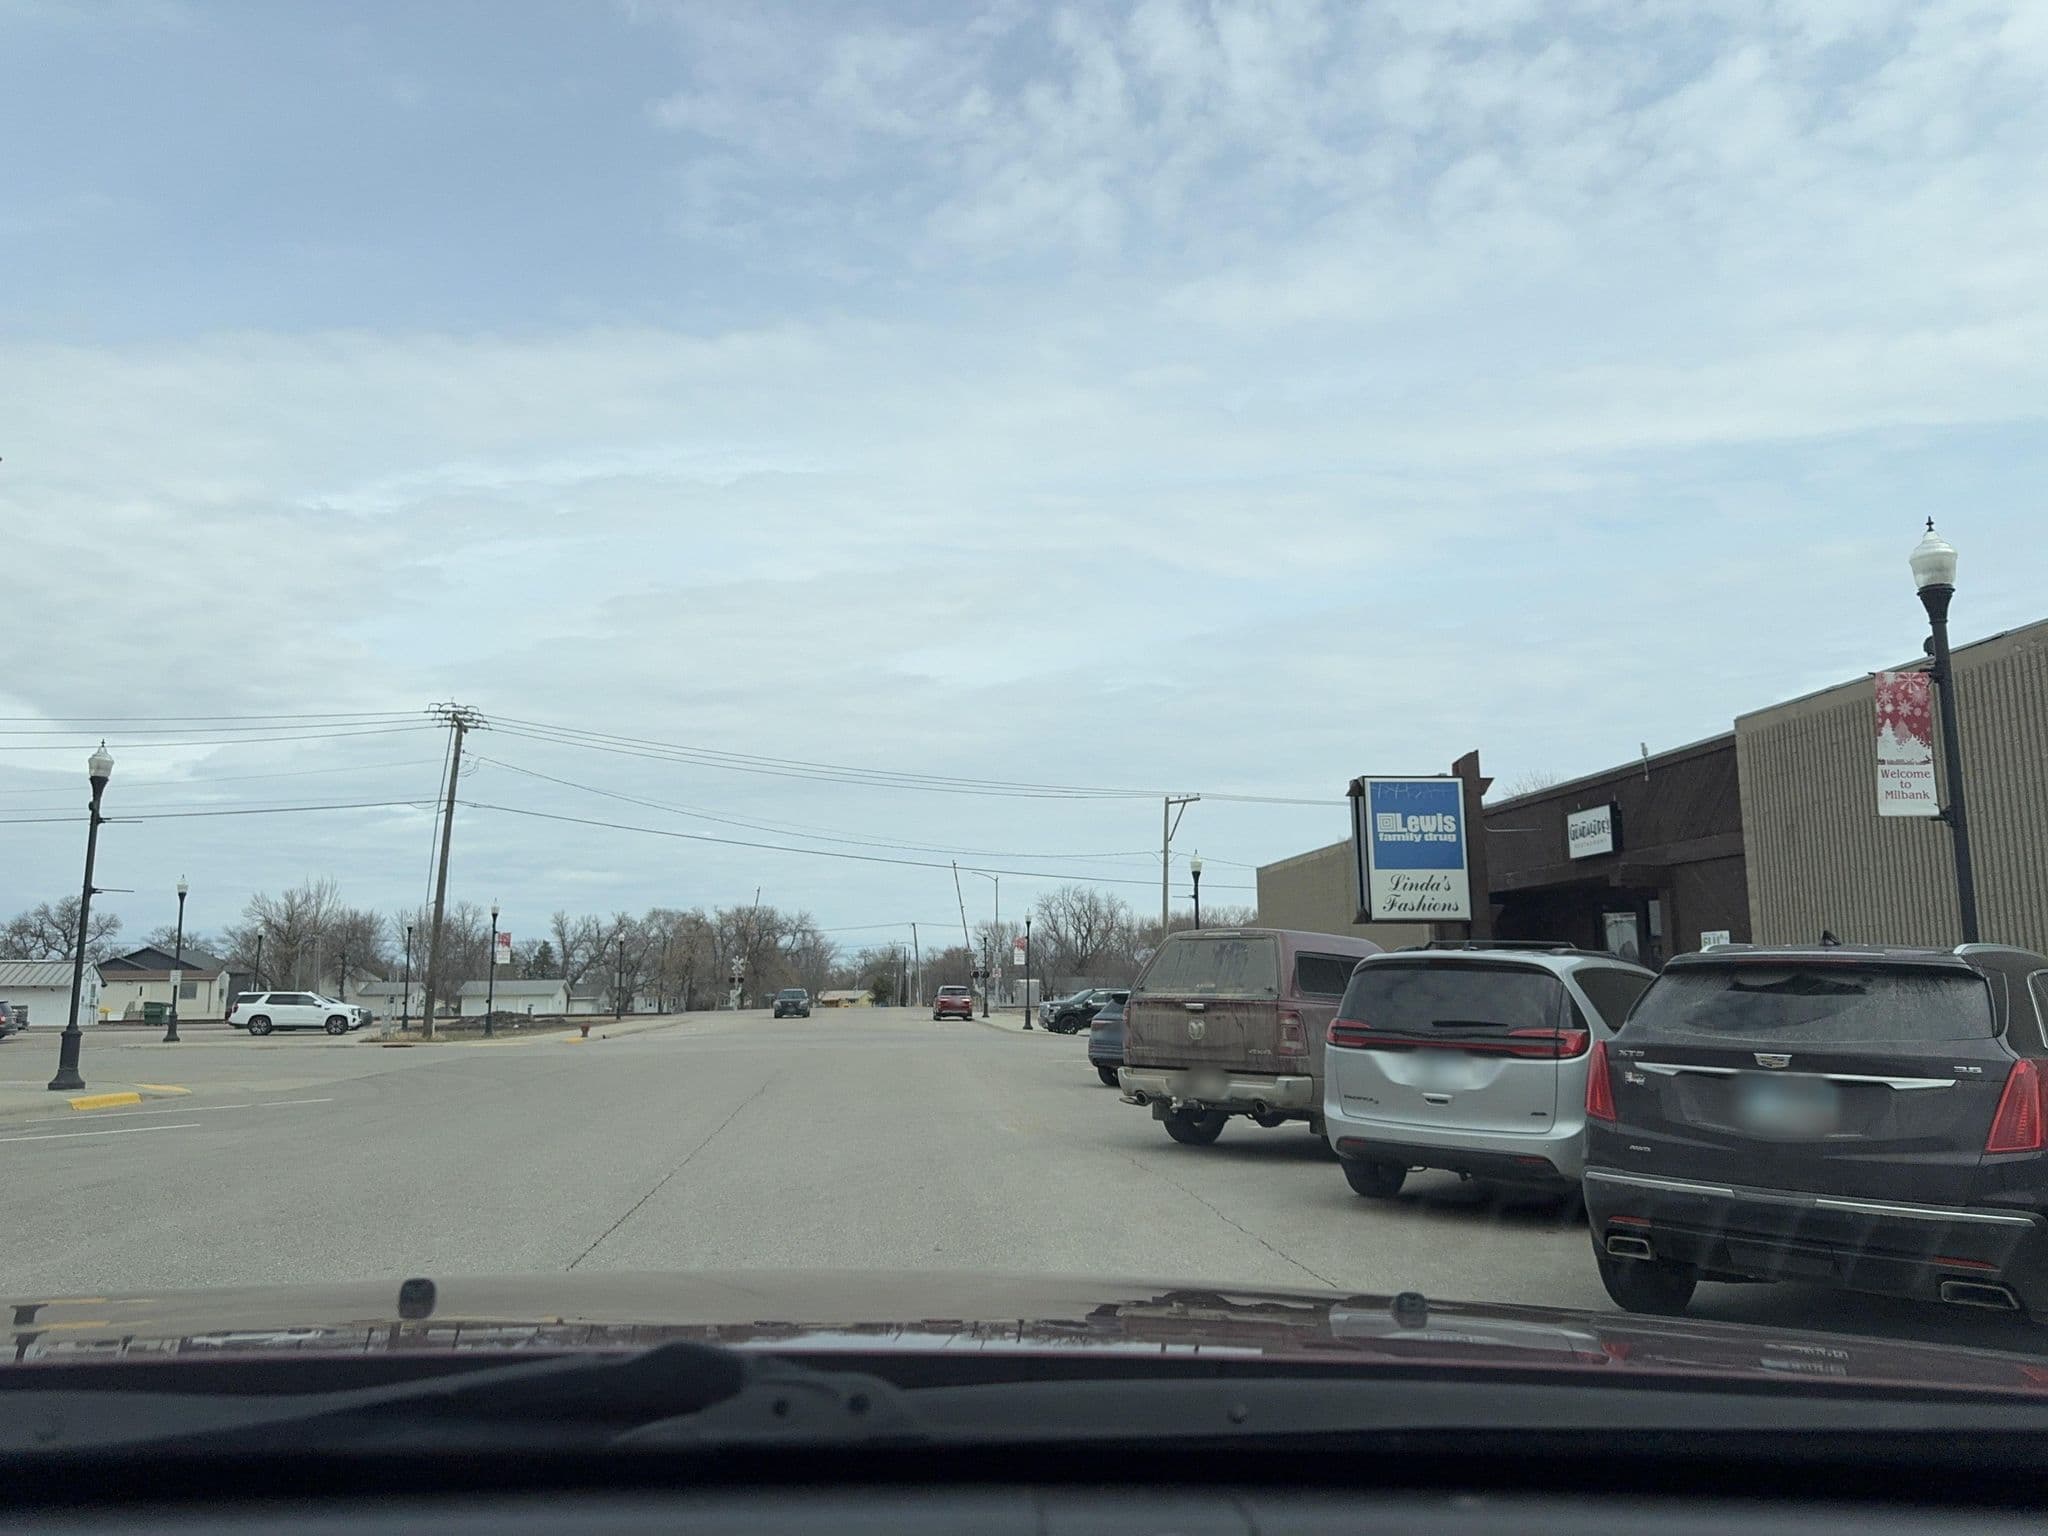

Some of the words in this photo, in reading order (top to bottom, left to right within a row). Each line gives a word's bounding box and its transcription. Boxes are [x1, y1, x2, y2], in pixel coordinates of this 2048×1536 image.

[1880, 768, 1931, 779] Welcome
[1900, 780, 1912, 789] to
[1885, 790, 1930, 800] Milbank
[1395, 813, 1457, 833] Lewis
[1379, 832, 1421, 843] family
[1423, 833, 1457, 843] drug
[1388, 873, 1452, 892] Linda's
[1382, 894, 1459, 912] Fashions
